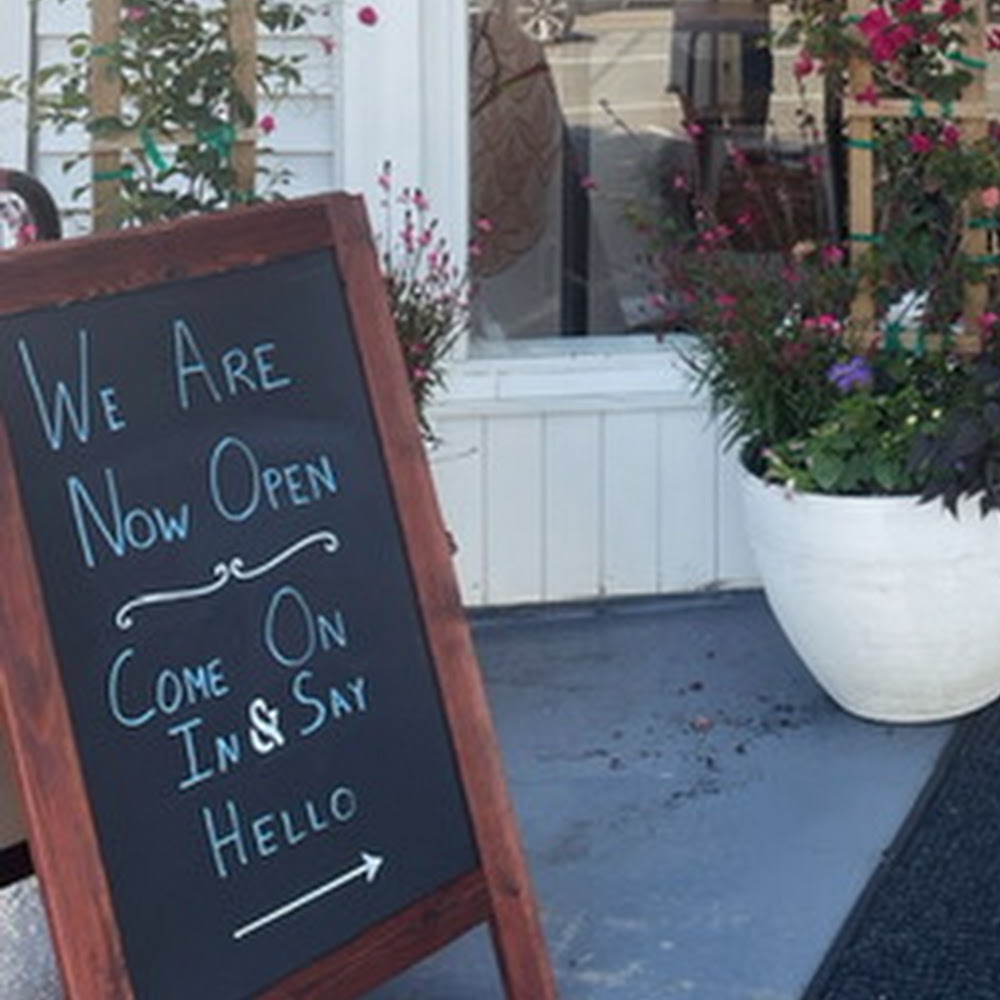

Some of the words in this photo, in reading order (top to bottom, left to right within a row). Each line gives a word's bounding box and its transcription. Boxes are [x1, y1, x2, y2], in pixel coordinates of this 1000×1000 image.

[18, 330, 126, 451] WE
[172, 319, 291, 410] ARE
[67, 468, 190, 567] NOW
[209, 437, 338, 522] OPEN
[108, 648, 230, 727] COME
[264, 586, 347, 667] ON
[168, 718, 241, 790] IN
[248, 697, 286, 754] &
[292, 670, 369, 736] SAY
[202, 787, 358, 878] HELLO
